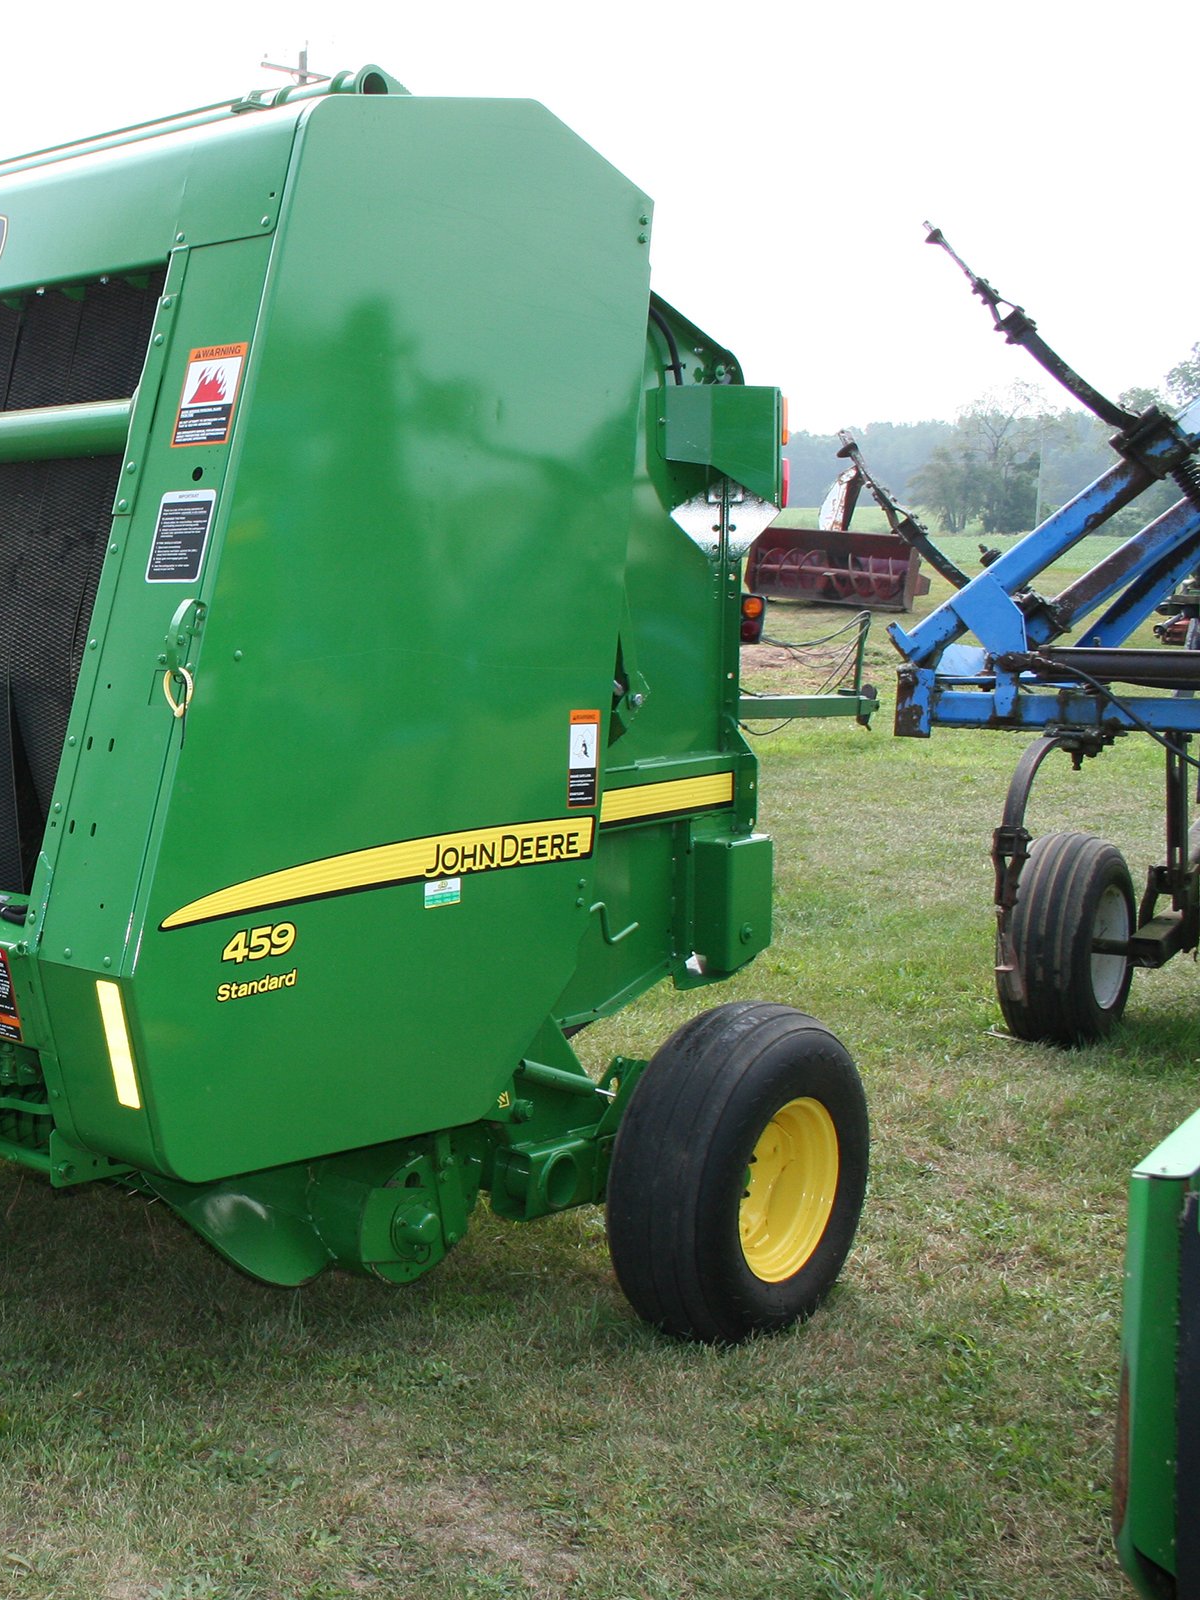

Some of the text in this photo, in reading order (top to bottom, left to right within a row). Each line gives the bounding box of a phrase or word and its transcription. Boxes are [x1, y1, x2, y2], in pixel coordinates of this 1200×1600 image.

[202, 346, 241, 357] WARNING
[425, 832, 580, 875] JOHN DEERE
[221, 921, 297, 965] 459
[216, 968, 298, 1003] Standard
